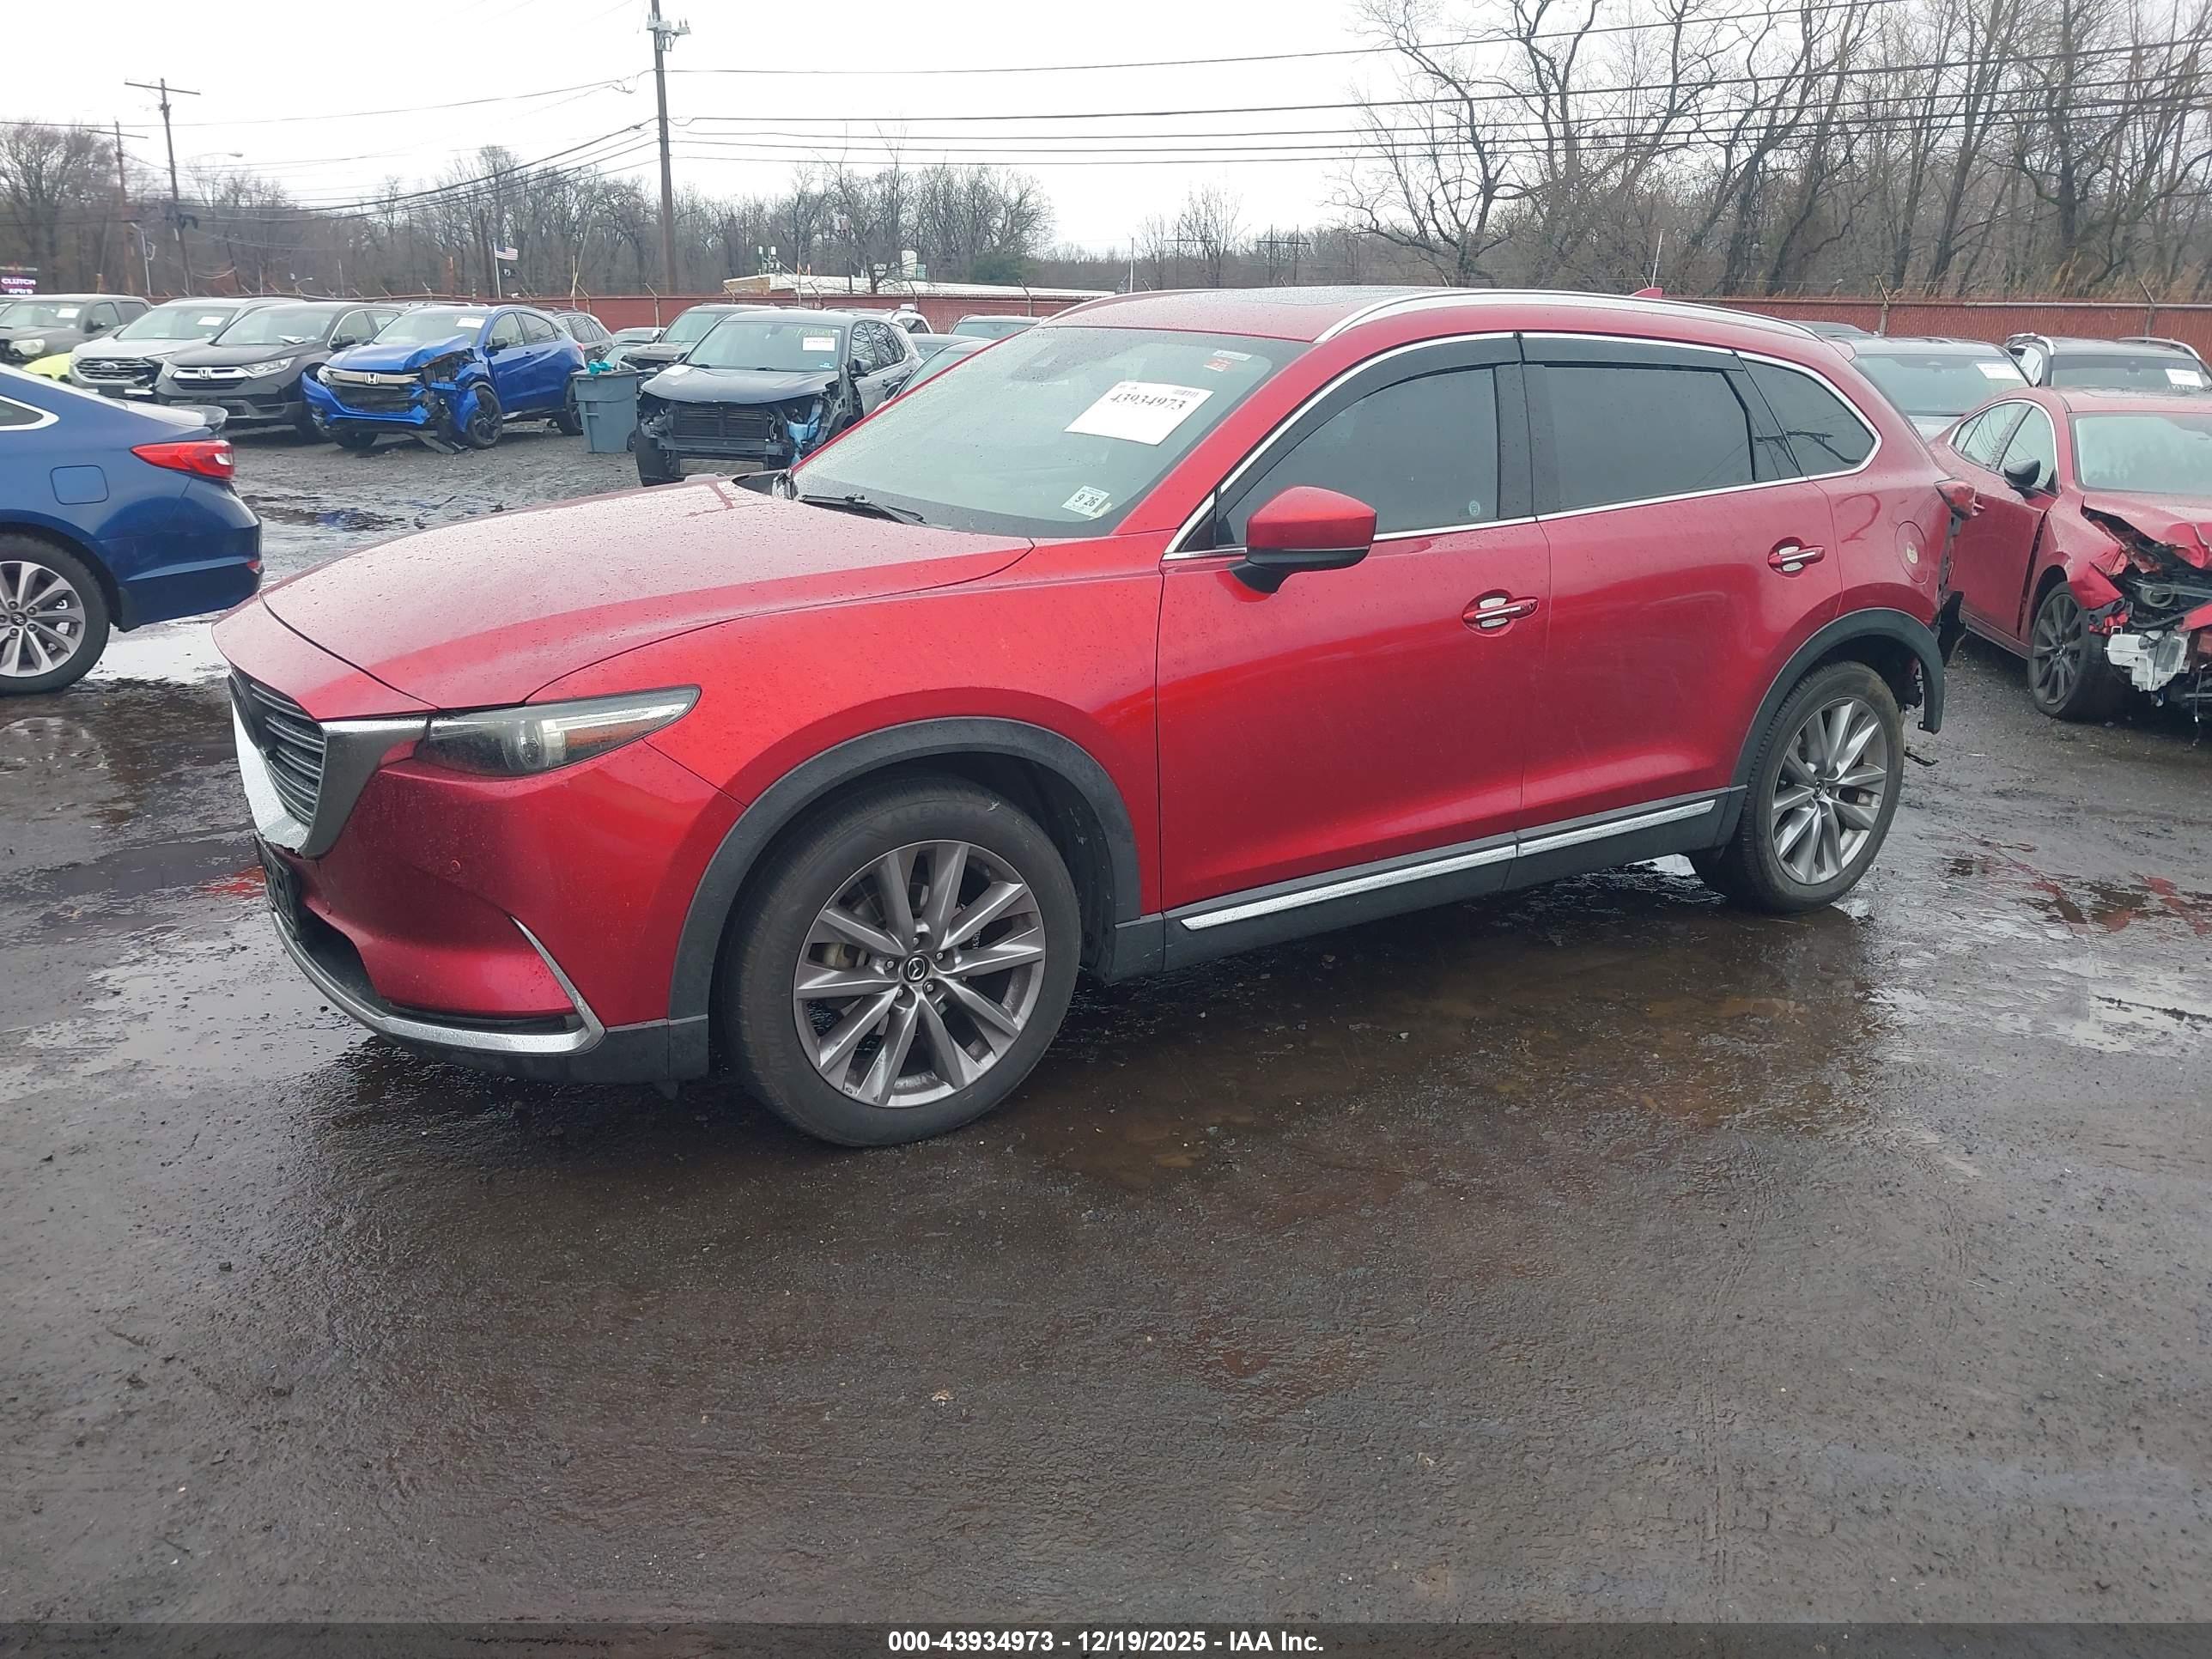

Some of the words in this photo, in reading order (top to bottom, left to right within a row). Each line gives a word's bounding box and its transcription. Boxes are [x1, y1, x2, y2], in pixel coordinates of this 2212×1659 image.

[1109, 393, 1187, 410] 43934973
[1075, 494, 1085, 502] 9
[1084, 496, 1099, 507] 26
